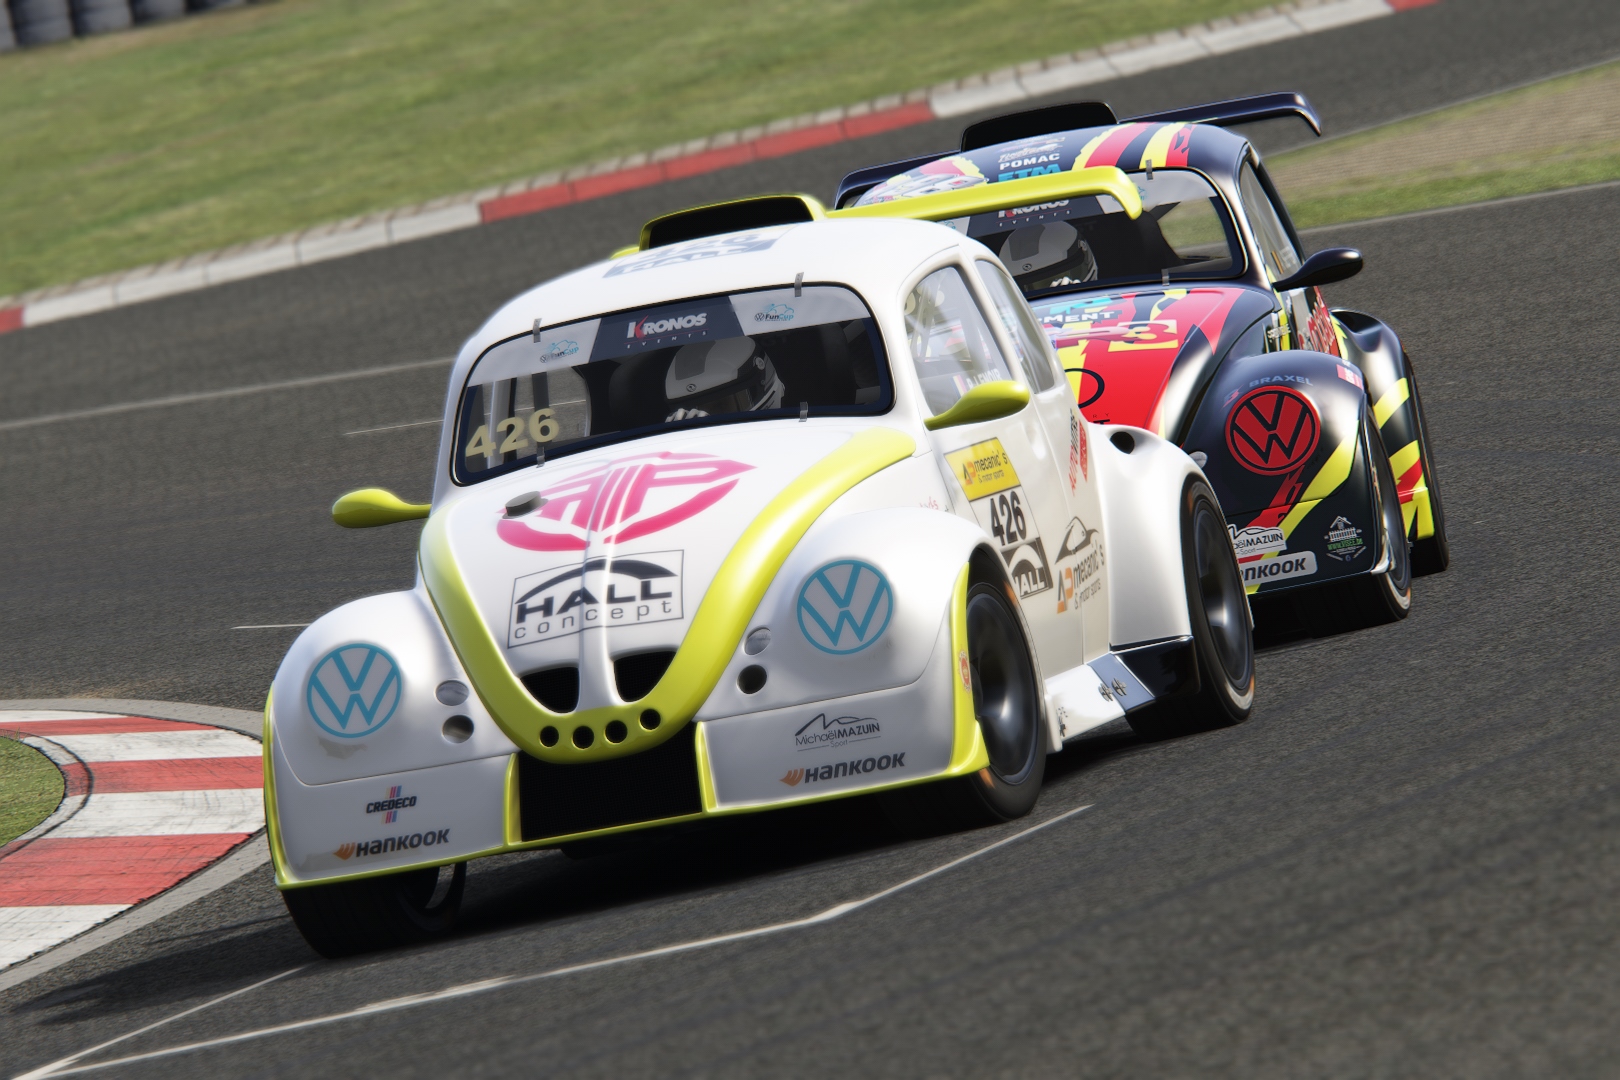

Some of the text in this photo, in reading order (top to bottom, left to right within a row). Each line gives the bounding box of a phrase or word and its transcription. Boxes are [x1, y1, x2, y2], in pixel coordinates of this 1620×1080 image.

[1000, 153, 1061, 171] POMAC
[1000, 209, 1072, 228] EVENTS
[626, 312, 708, 339] KRONOS
[626, 330, 707, 349] EVENTS
[1249, 375, 1313, 387] BRAXEL
[465, 408, 560, 458] 426
[990, 490, 1027, 546] 426
[516, 580, 673, 624] HALL
[514, 600, 673, 639] concept
[829, 739, 849, 749] Sport
[366, 796, 418, 814] CREDECO
